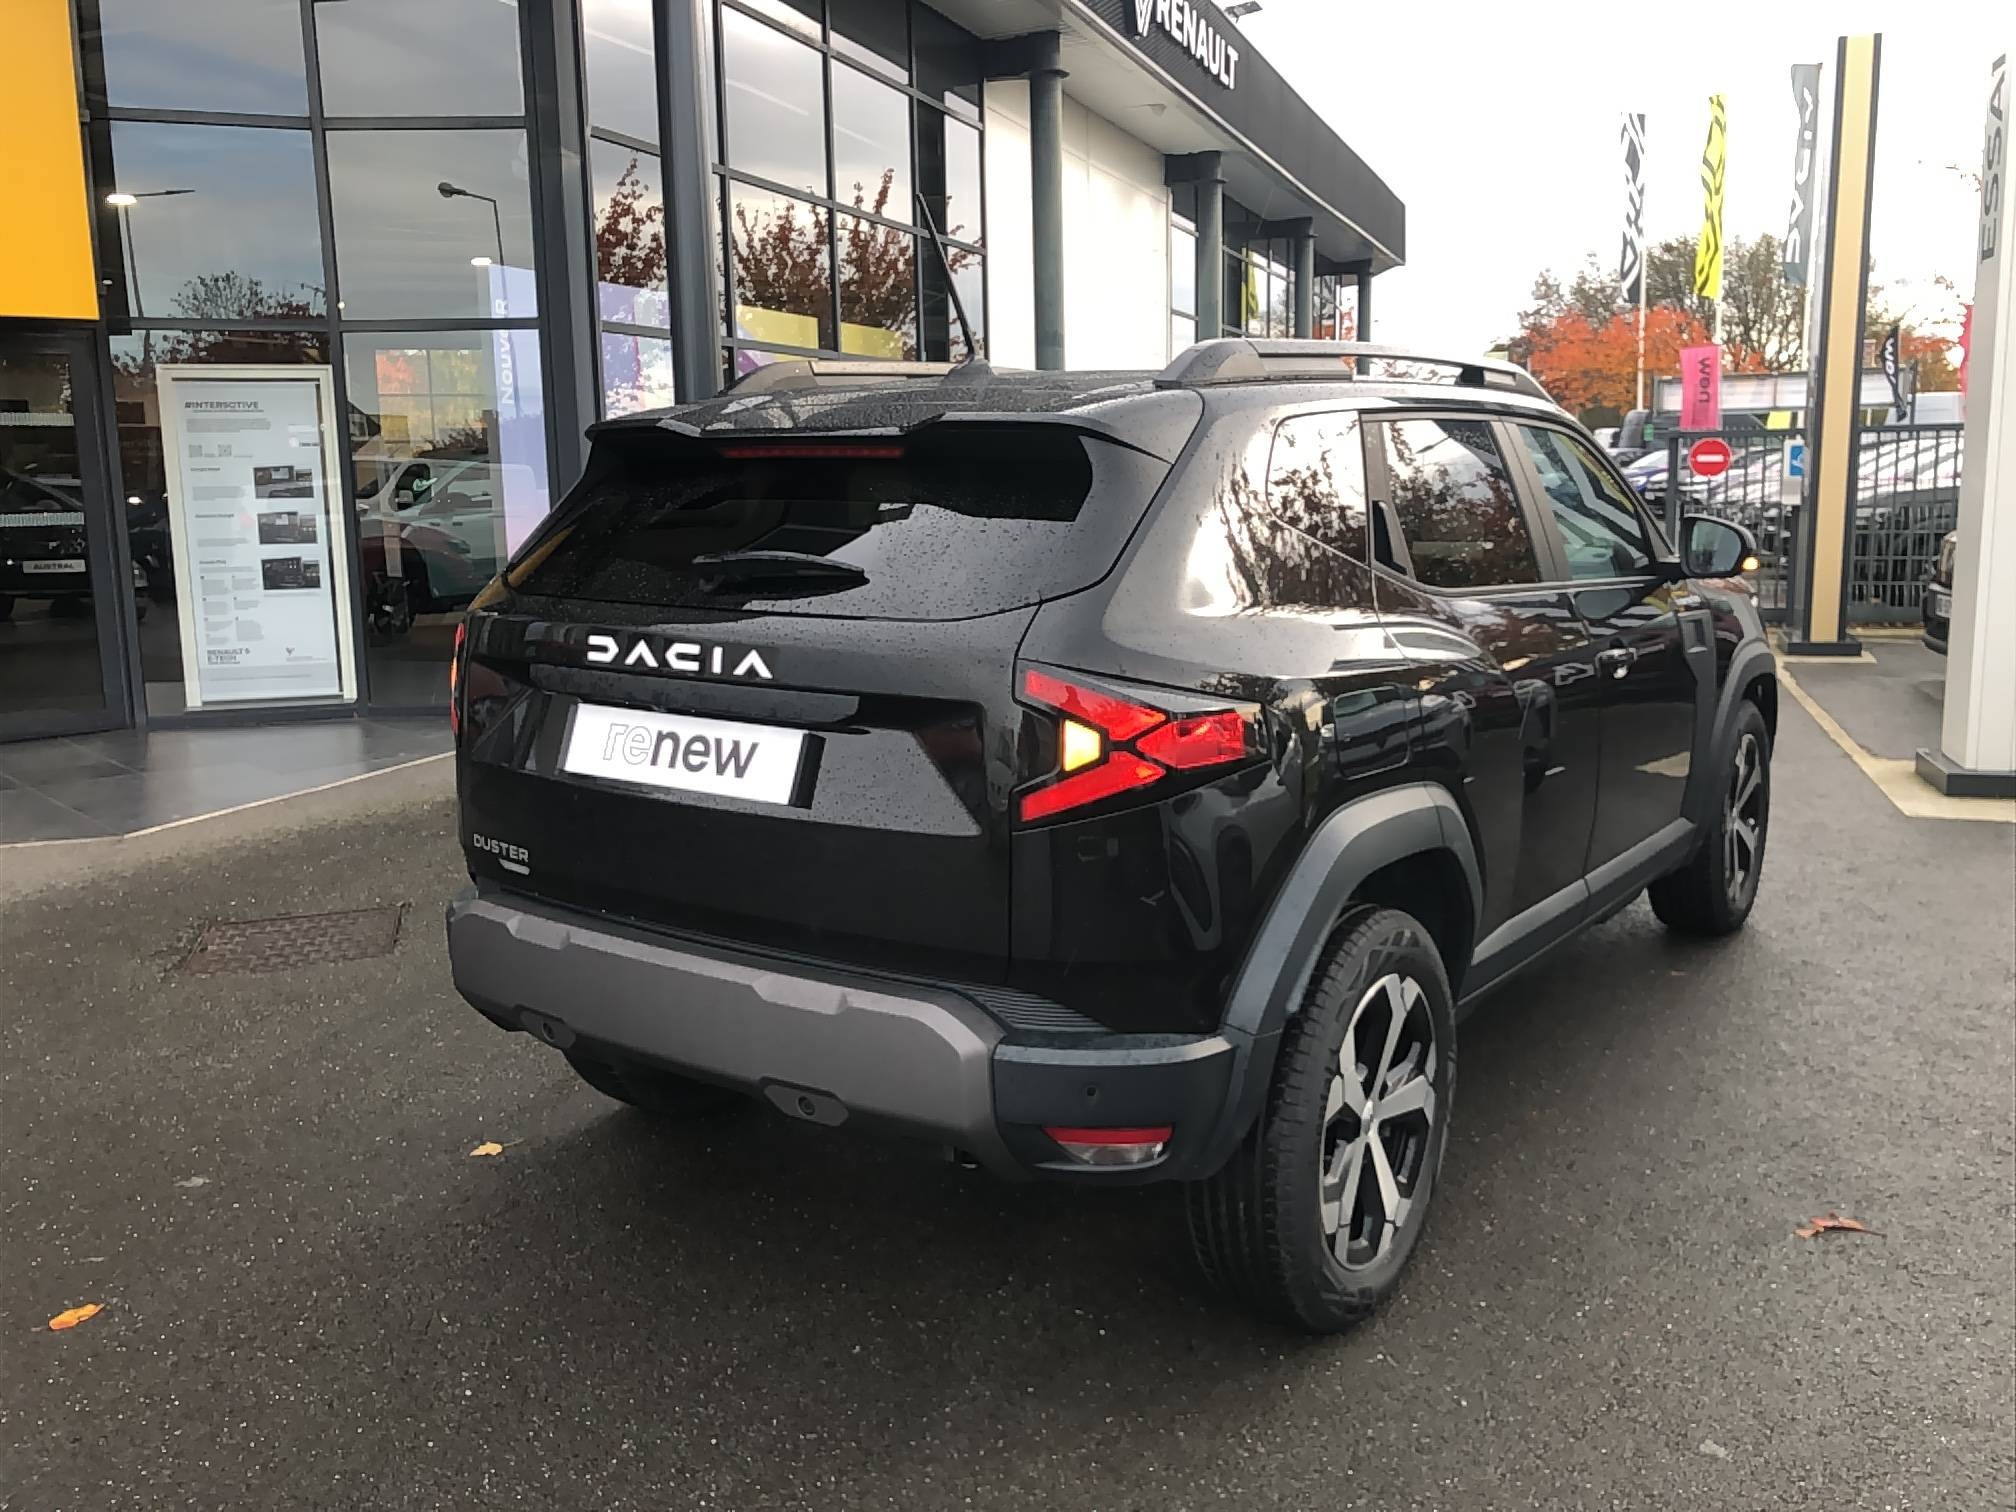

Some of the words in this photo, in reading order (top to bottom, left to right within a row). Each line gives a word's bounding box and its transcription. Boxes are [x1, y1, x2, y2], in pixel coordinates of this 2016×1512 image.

[1156, 0, 1239, 90] RENAULT
[586, 634, 774, 680] DACIA
[602, 722, 760, 779] renew
[473, 833, 529, 863] DUSTER
